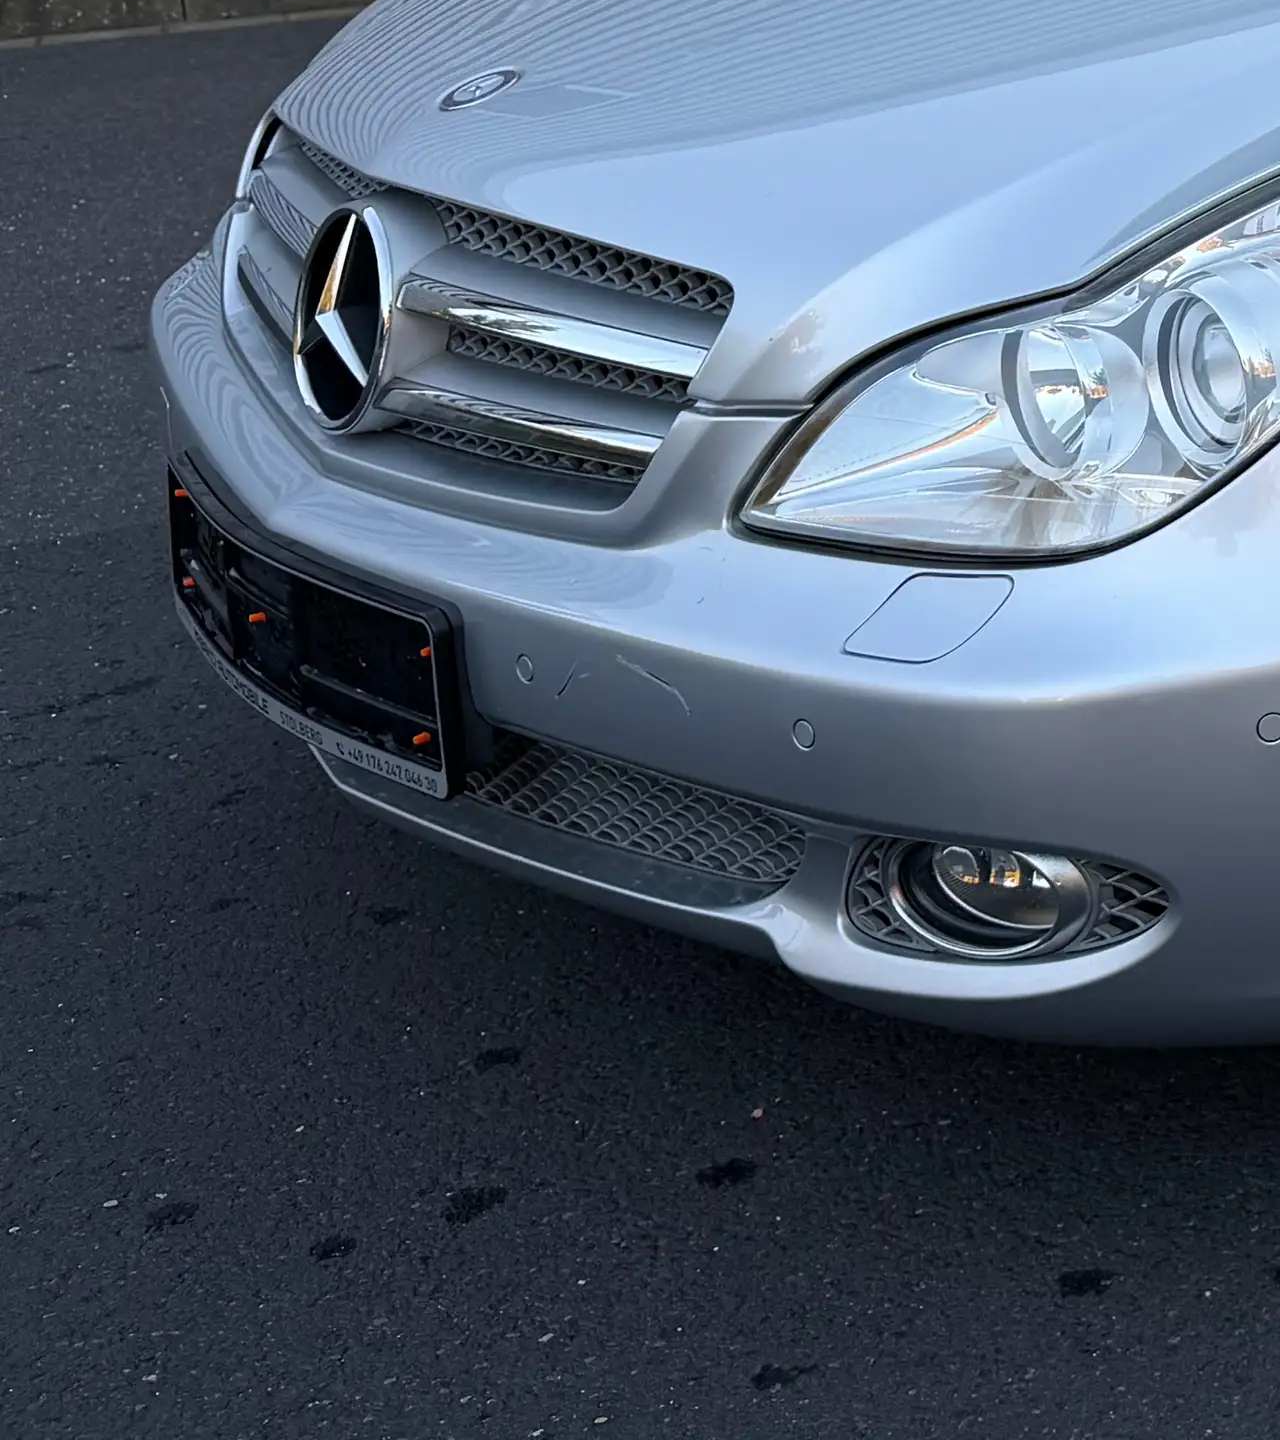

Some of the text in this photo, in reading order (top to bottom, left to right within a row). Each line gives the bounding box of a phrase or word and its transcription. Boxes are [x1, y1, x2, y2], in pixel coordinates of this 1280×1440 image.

[279, 710, 324, 746] STOLBERG
[348, 747, 364, 764] +49
[366, 751, 384, 772] 176
